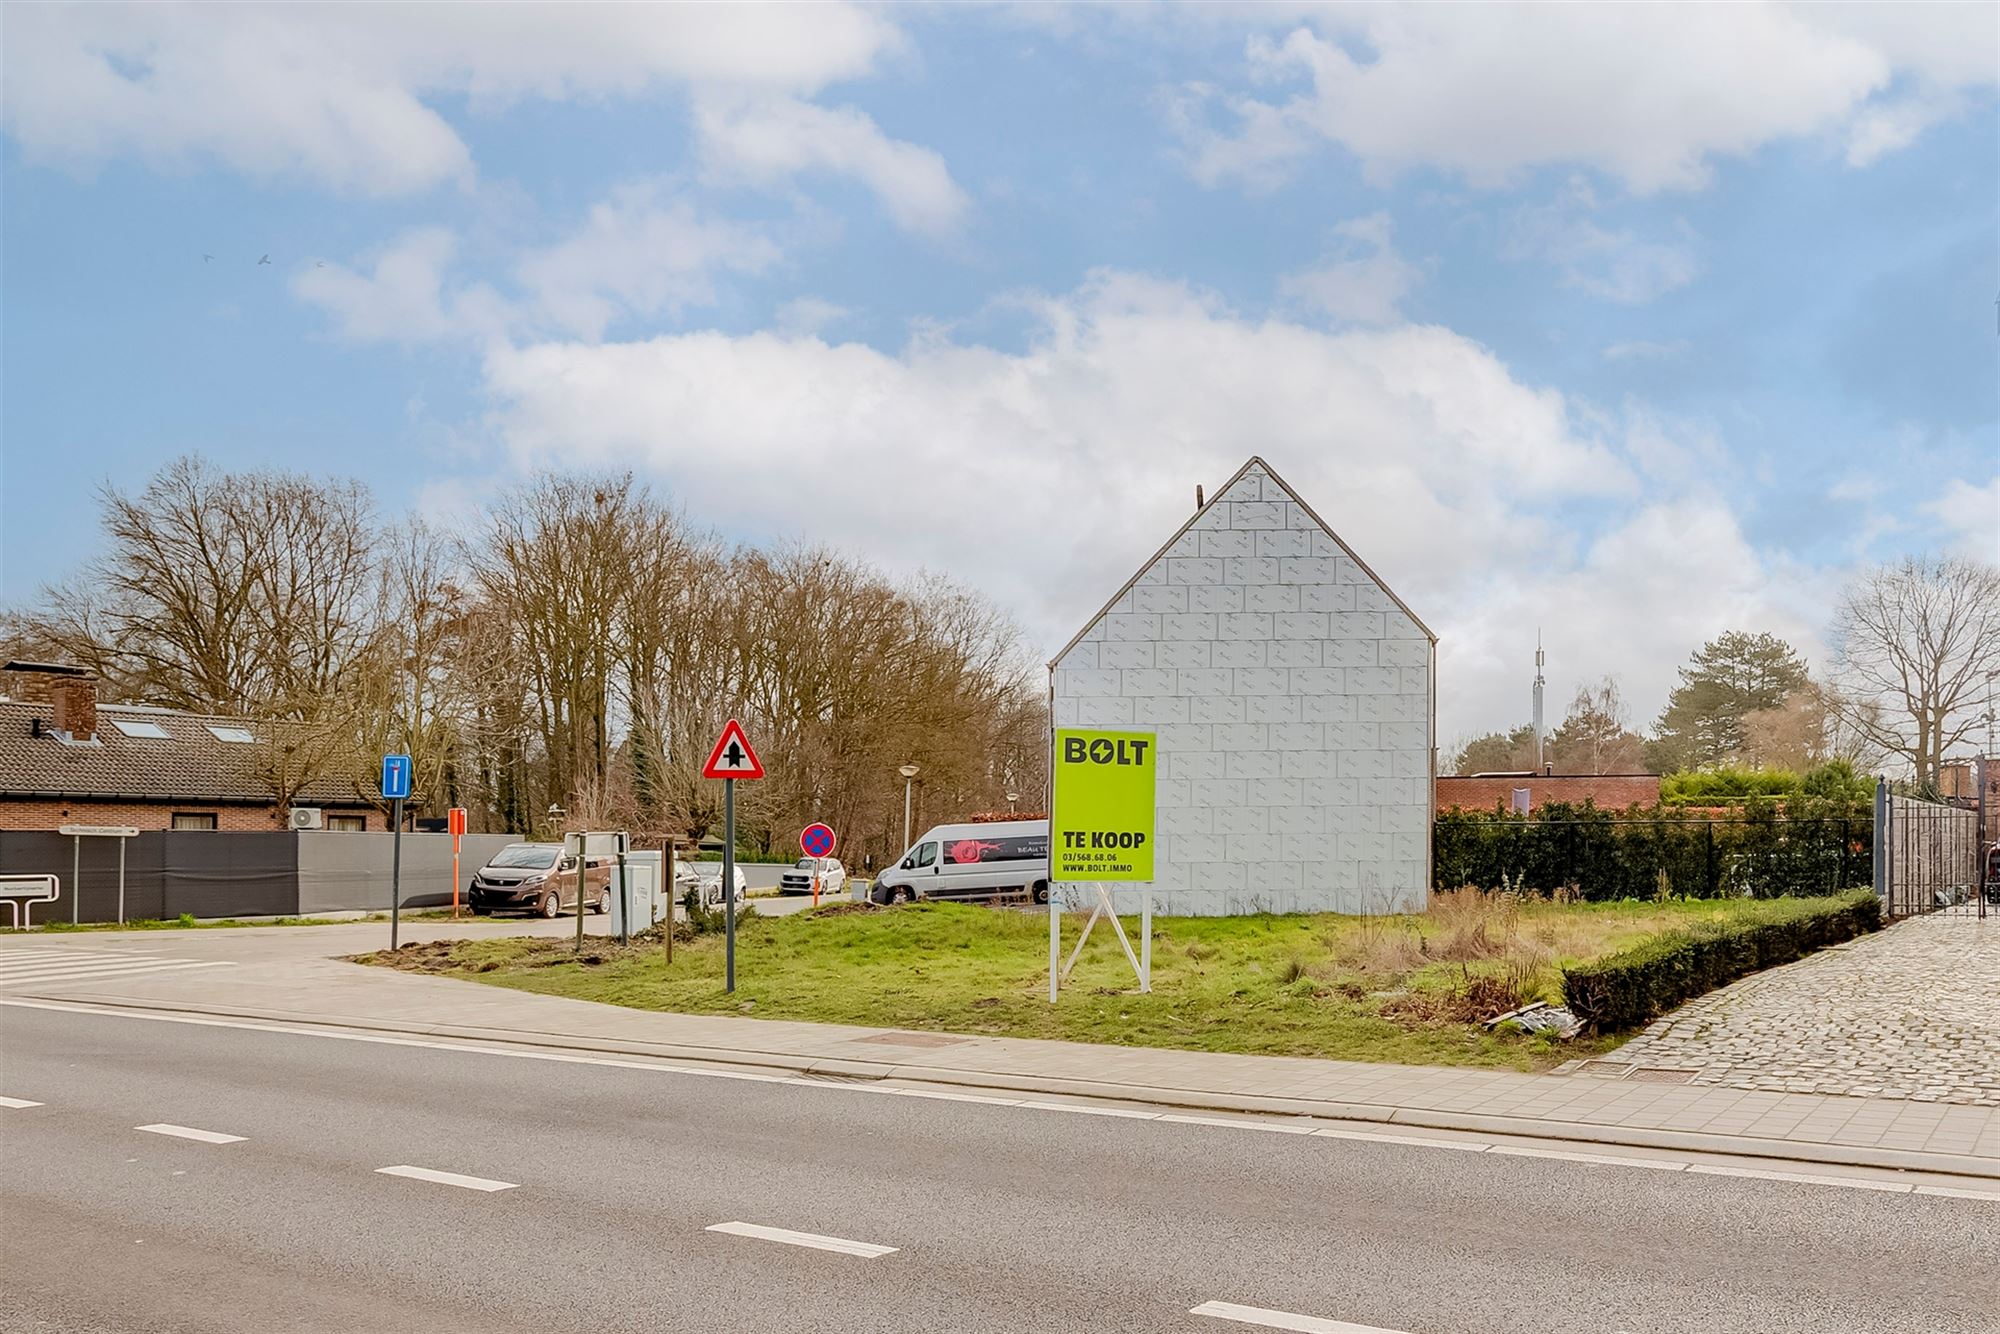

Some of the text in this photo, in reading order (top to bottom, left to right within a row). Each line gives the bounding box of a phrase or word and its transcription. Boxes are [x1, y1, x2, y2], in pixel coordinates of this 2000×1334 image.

[1064, 737, 1148, 766] BOLT
[1063, 831, 1146, 849] TE KOOP
[1062, 852, 1118, 862] 03/568.68.06
[1062, 864, 1133, 873] WWW.BOLT.IMMO
